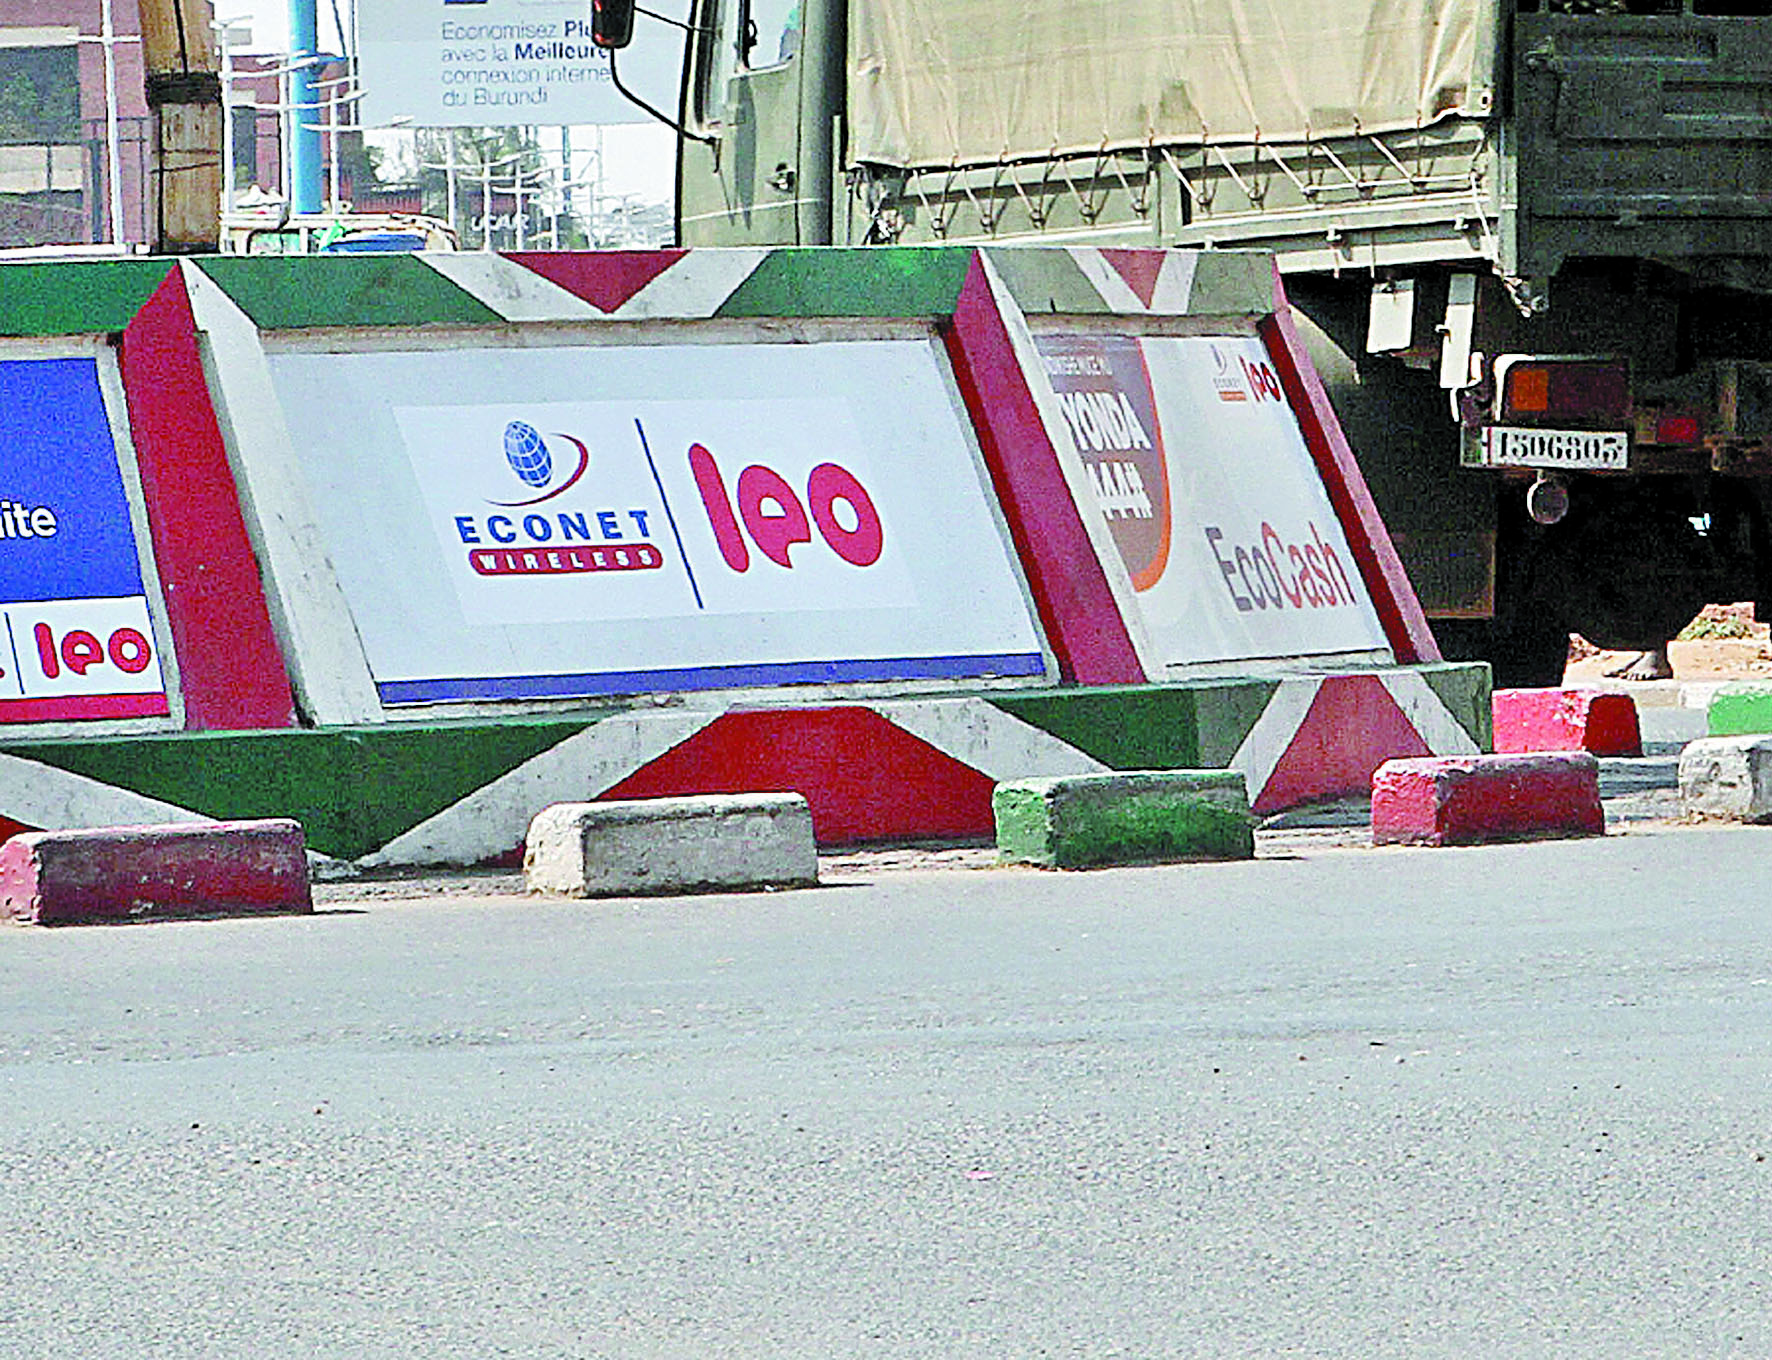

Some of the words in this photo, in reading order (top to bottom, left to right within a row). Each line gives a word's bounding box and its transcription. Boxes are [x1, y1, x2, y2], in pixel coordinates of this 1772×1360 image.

[441, 20, 557, 41] Economisez
[441, 46, 486, 62] avec
[492, 43, 508, 62] la
[441, 66, 540, 84] connexion
[442, 89, 467, 107] du
[474, 86, 548, 106] Burundi
[0, 500, 57, 538] ite
[688, 442, 884, 573] leo
[453, 509, 649, 544] ECONET
[476, 547, 655, 572] WIRELESS
[1204, 520, 1357, 613] EcoCash
[33, 622, 151, 679] leo
